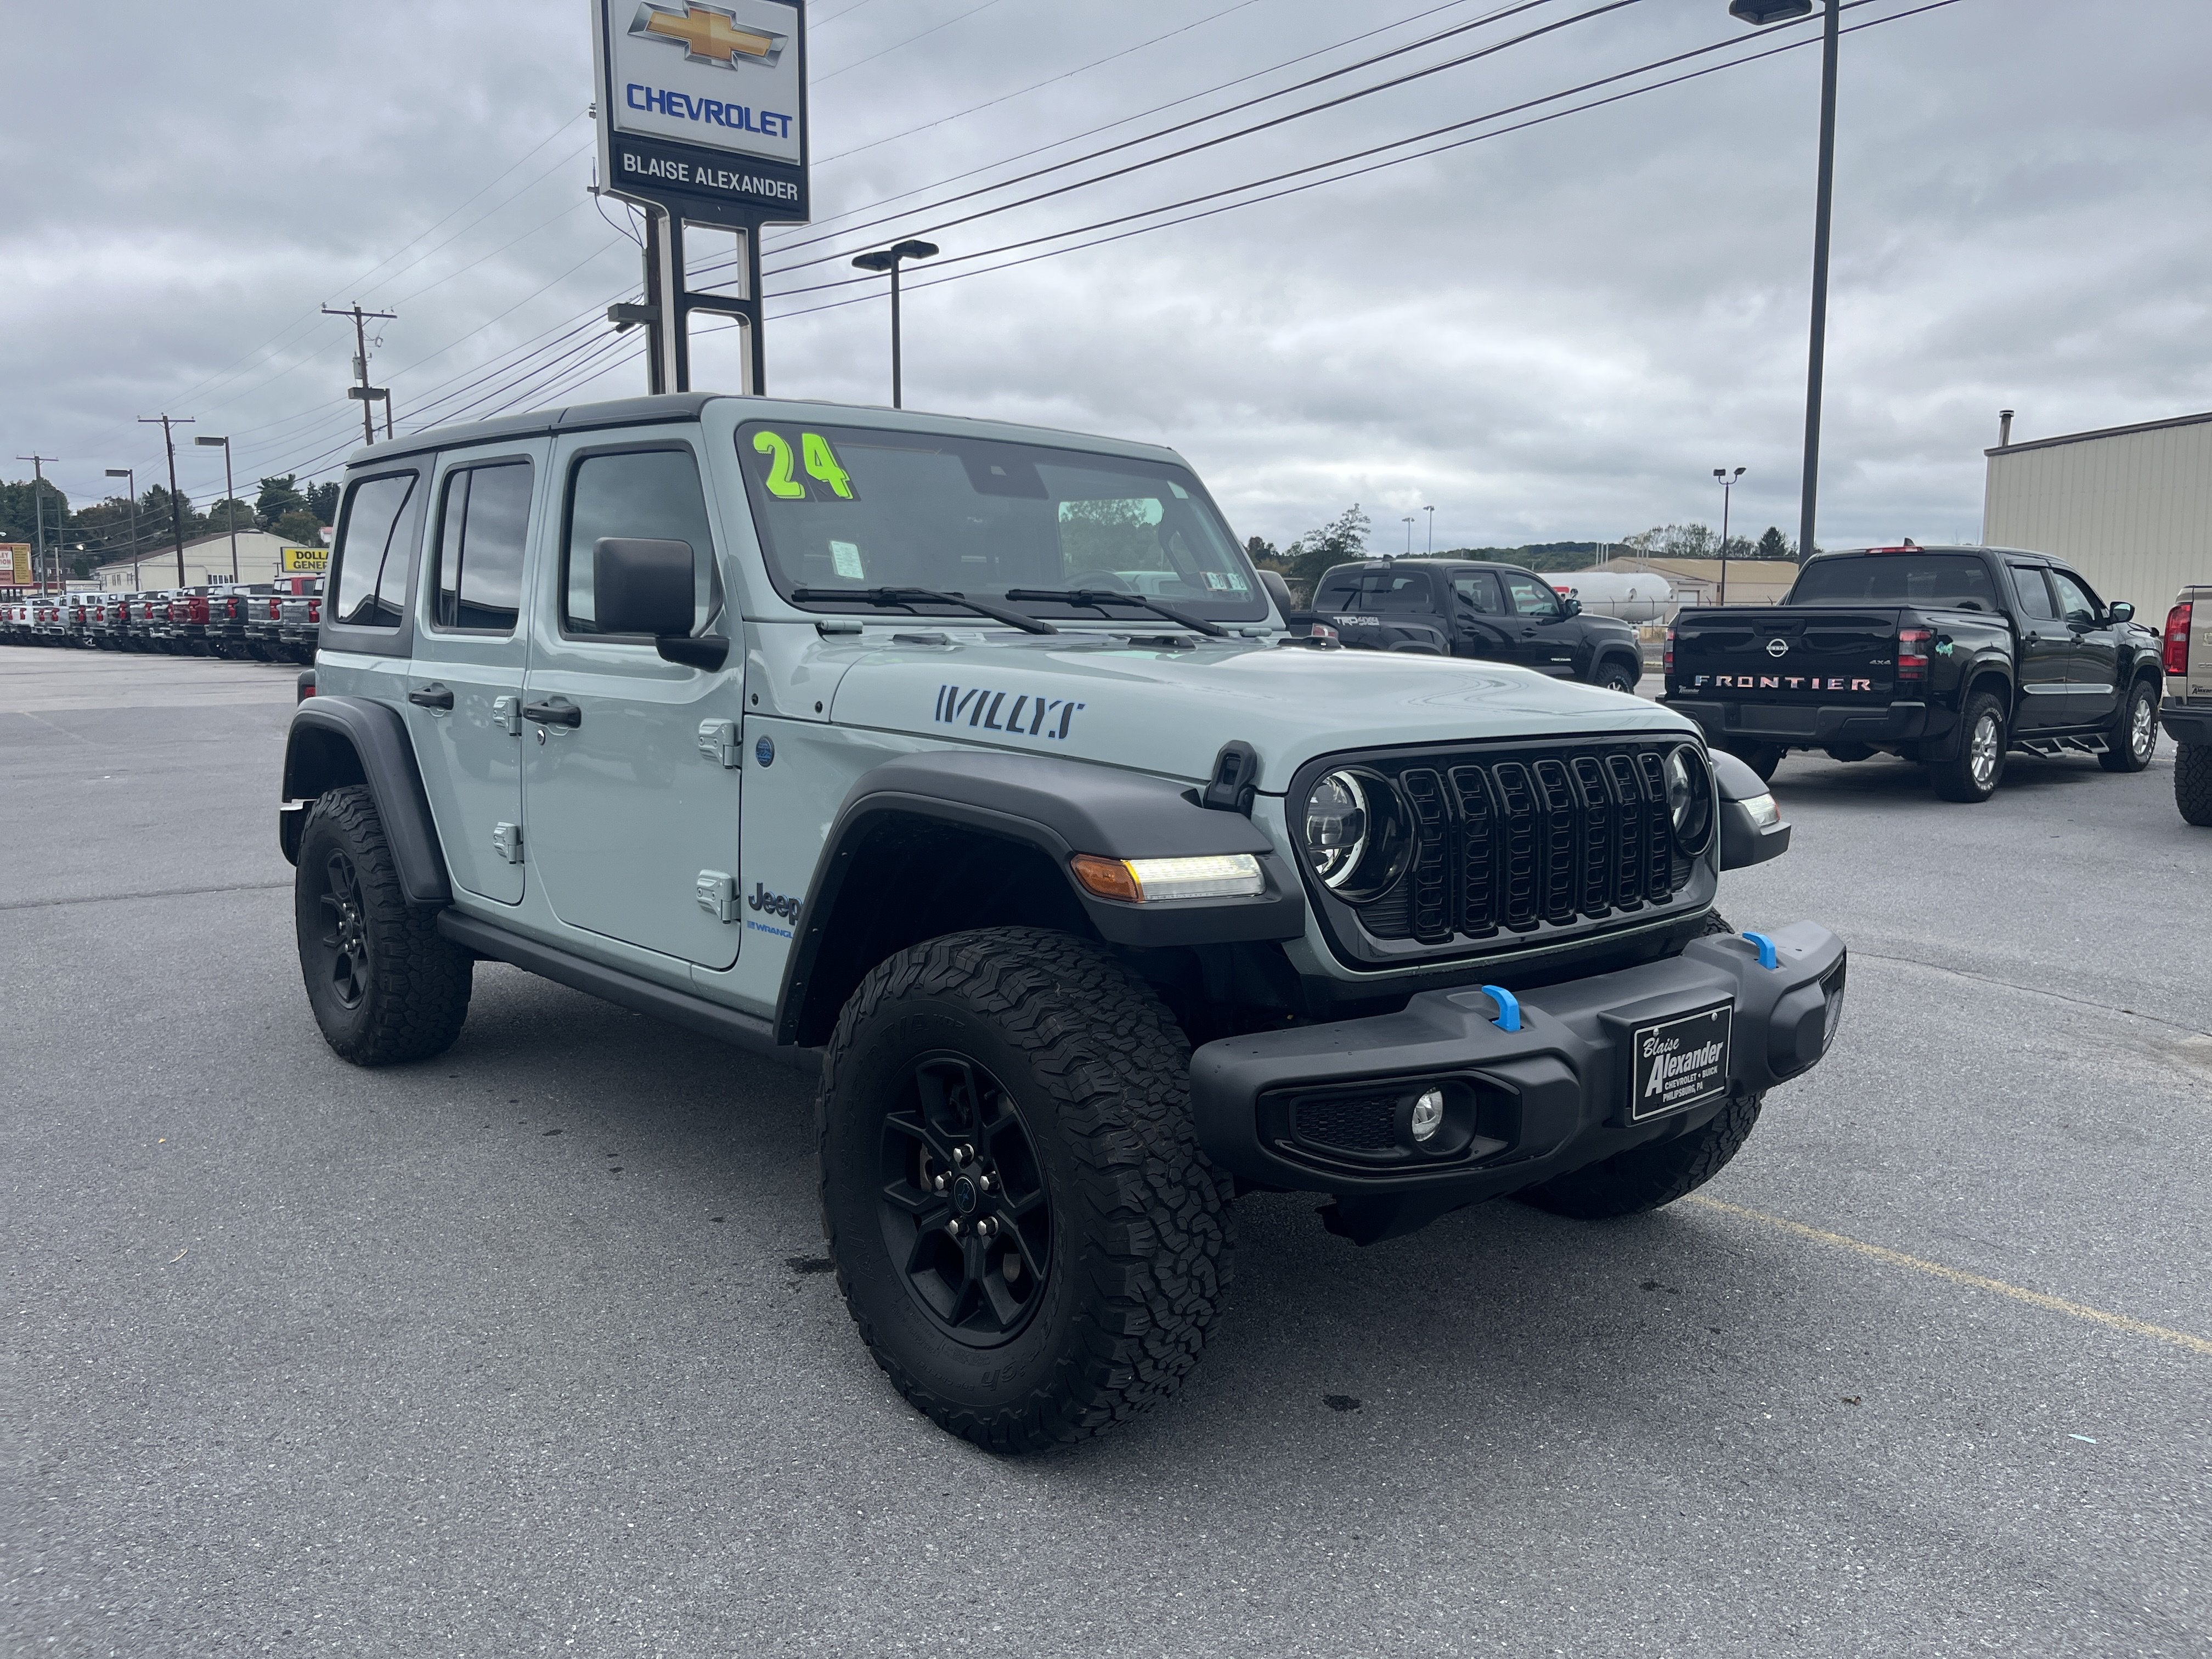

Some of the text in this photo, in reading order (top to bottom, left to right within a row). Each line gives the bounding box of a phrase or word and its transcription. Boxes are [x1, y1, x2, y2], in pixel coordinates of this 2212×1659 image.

[627, 83, 792, 138] CHEVROLET
[623, 153, 798, 201] BLAISE ALEXANDER
[752, 431, 854, 500] 24
[1695, 675, 1871, 691] FRONTIER
[934, 684, 1086, 741] WILLYS
[748, 882, 803, 926] Jeep
[1643, 1037, 1679, 1058] Blaise
[1645, 1040, 1724, 1098] Alexander
[1664, 1065, 1718, 1091] CHEVROLET BUICK
[1696, 1081, 1703, 1091] PA
